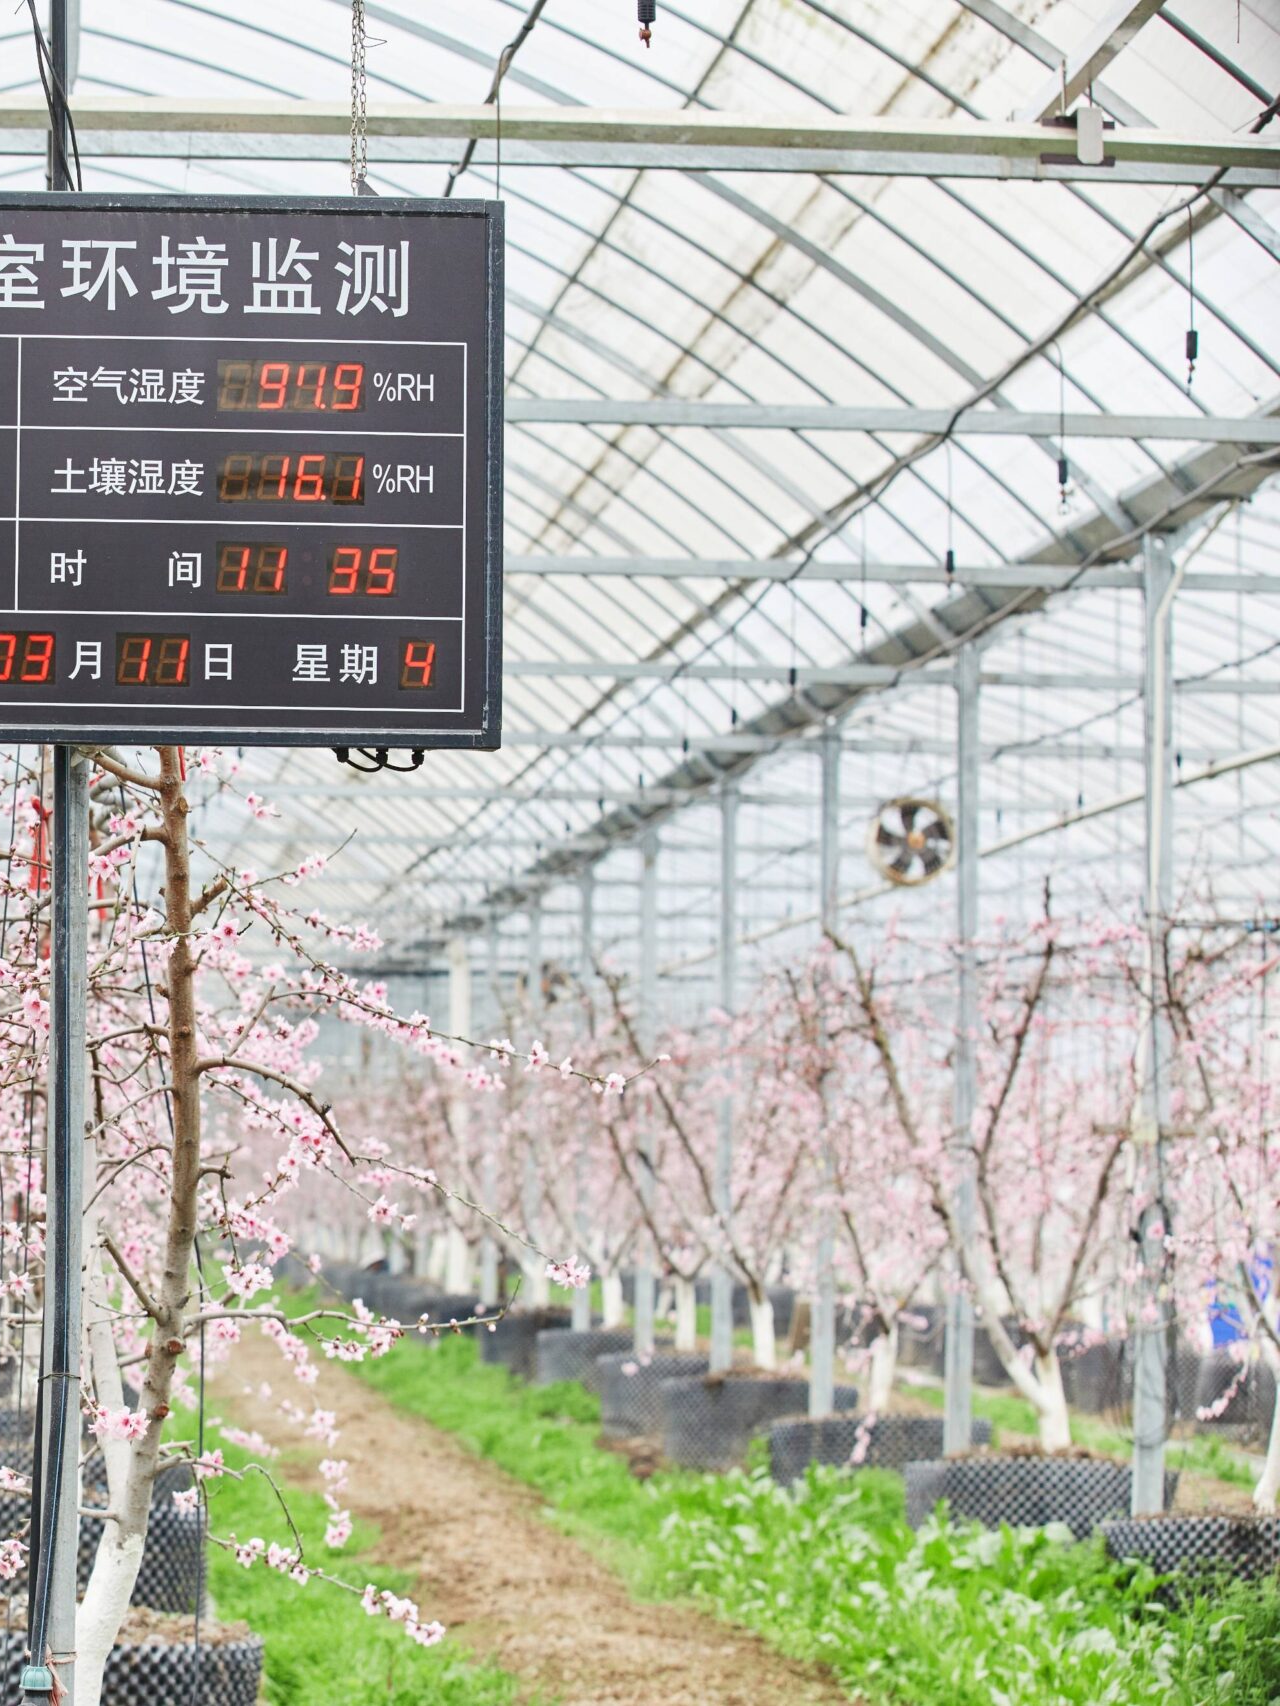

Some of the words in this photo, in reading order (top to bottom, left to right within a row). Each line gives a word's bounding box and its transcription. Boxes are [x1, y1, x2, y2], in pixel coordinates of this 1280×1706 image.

[52, 366, 206, 406] 空气湿度
[372, 372, 435, 402] %RH
[50, 457, 205, 497] 土壤湿度
[277, 455, 364, 501] 16.1
[372, 463, 434, 494] %RH
[236, 548, 287, 590] 11
[328, 548, 398, 594] 35
[138, 639, 189, 682] 11
[292, 643, 378, 685] 星期
[405, 643, 435, 685] 4
